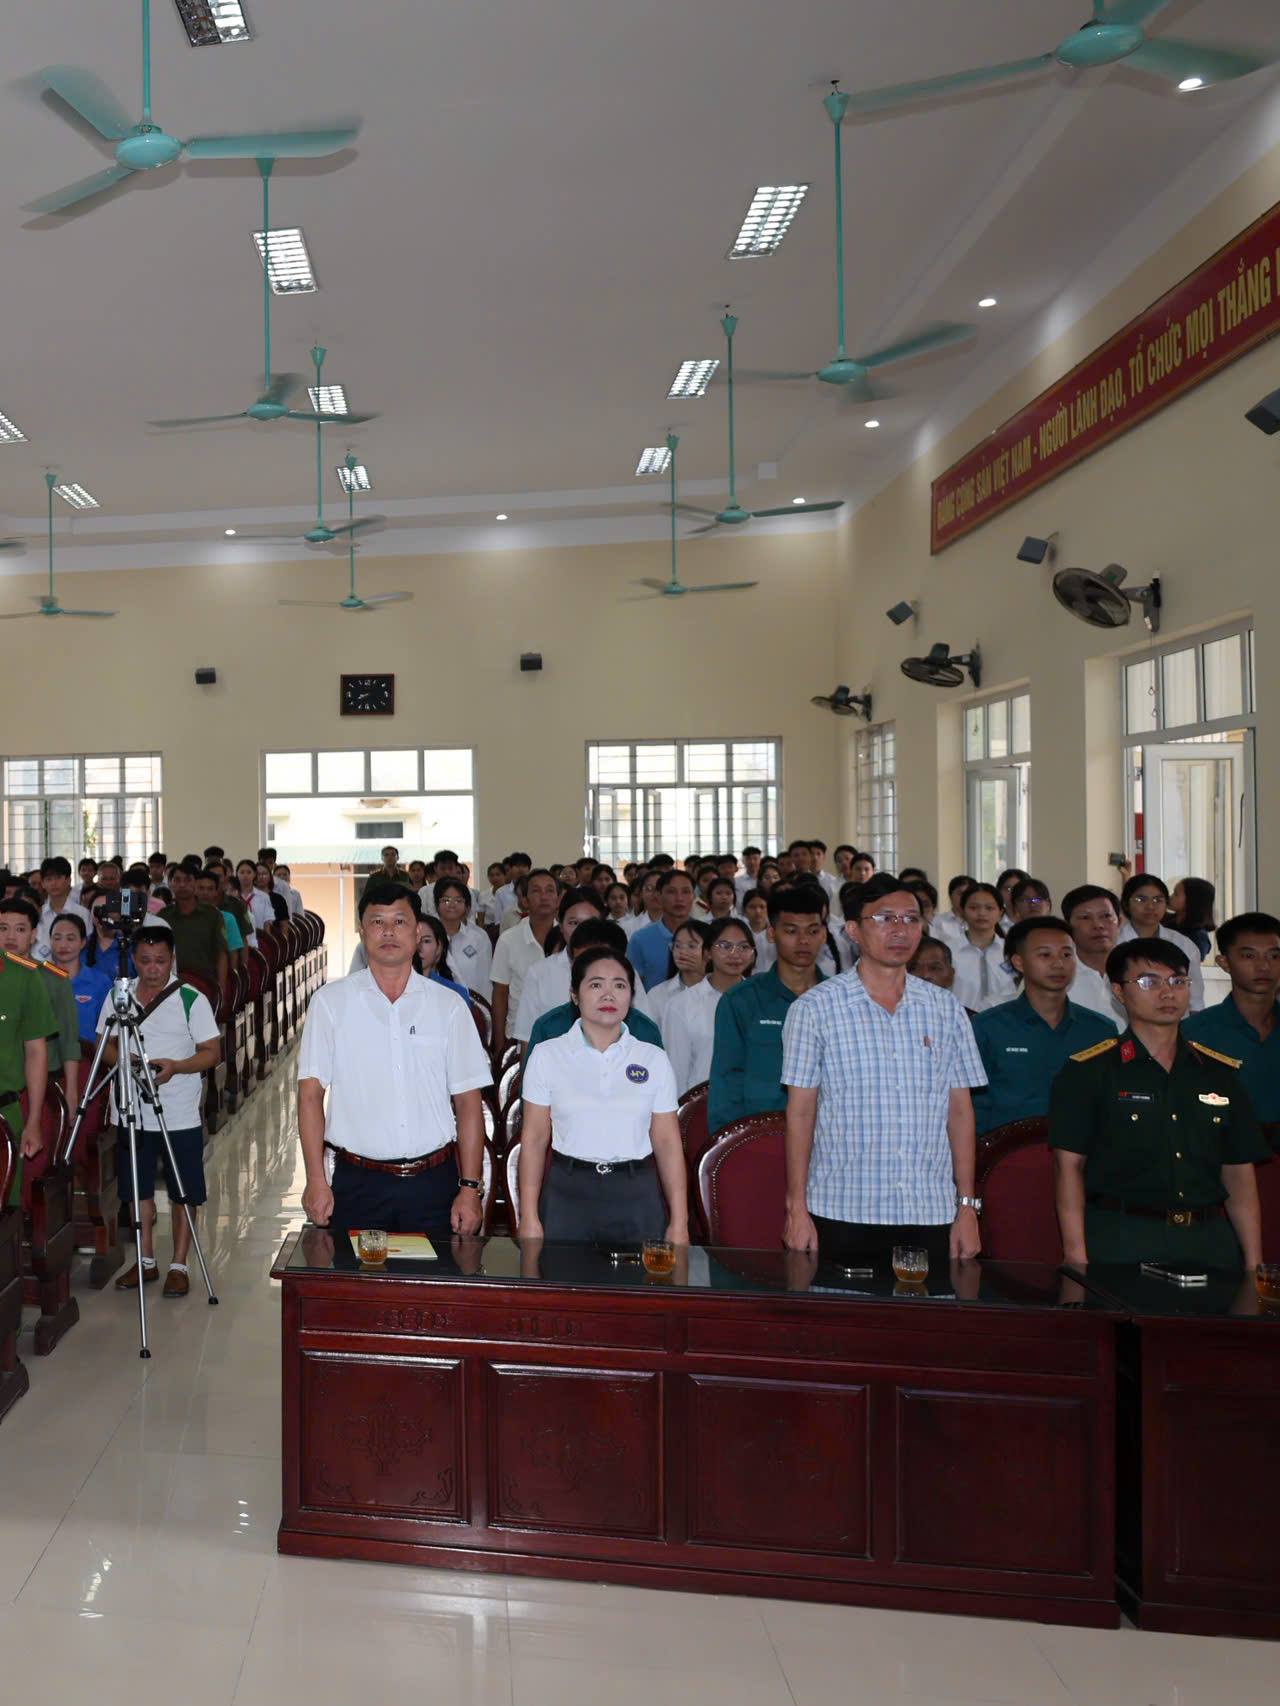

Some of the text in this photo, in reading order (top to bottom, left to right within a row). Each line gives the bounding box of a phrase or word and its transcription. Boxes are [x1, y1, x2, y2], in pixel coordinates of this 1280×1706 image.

[1011, 434, 1032, 480] NAM
[1039, 401, 1069, 461] NGƯỜI
[1070, 390, 1098, 439] LÃNH
[1100, 367, 1127, 422] ĐẠO,
[1128, 333, 1145, 398] TỔ
[1147, 317, 1183, 386] CHỨC
[1185, 297, 1215, 359] MỌI
[1217, 256, 1272, 336] THẮNG
